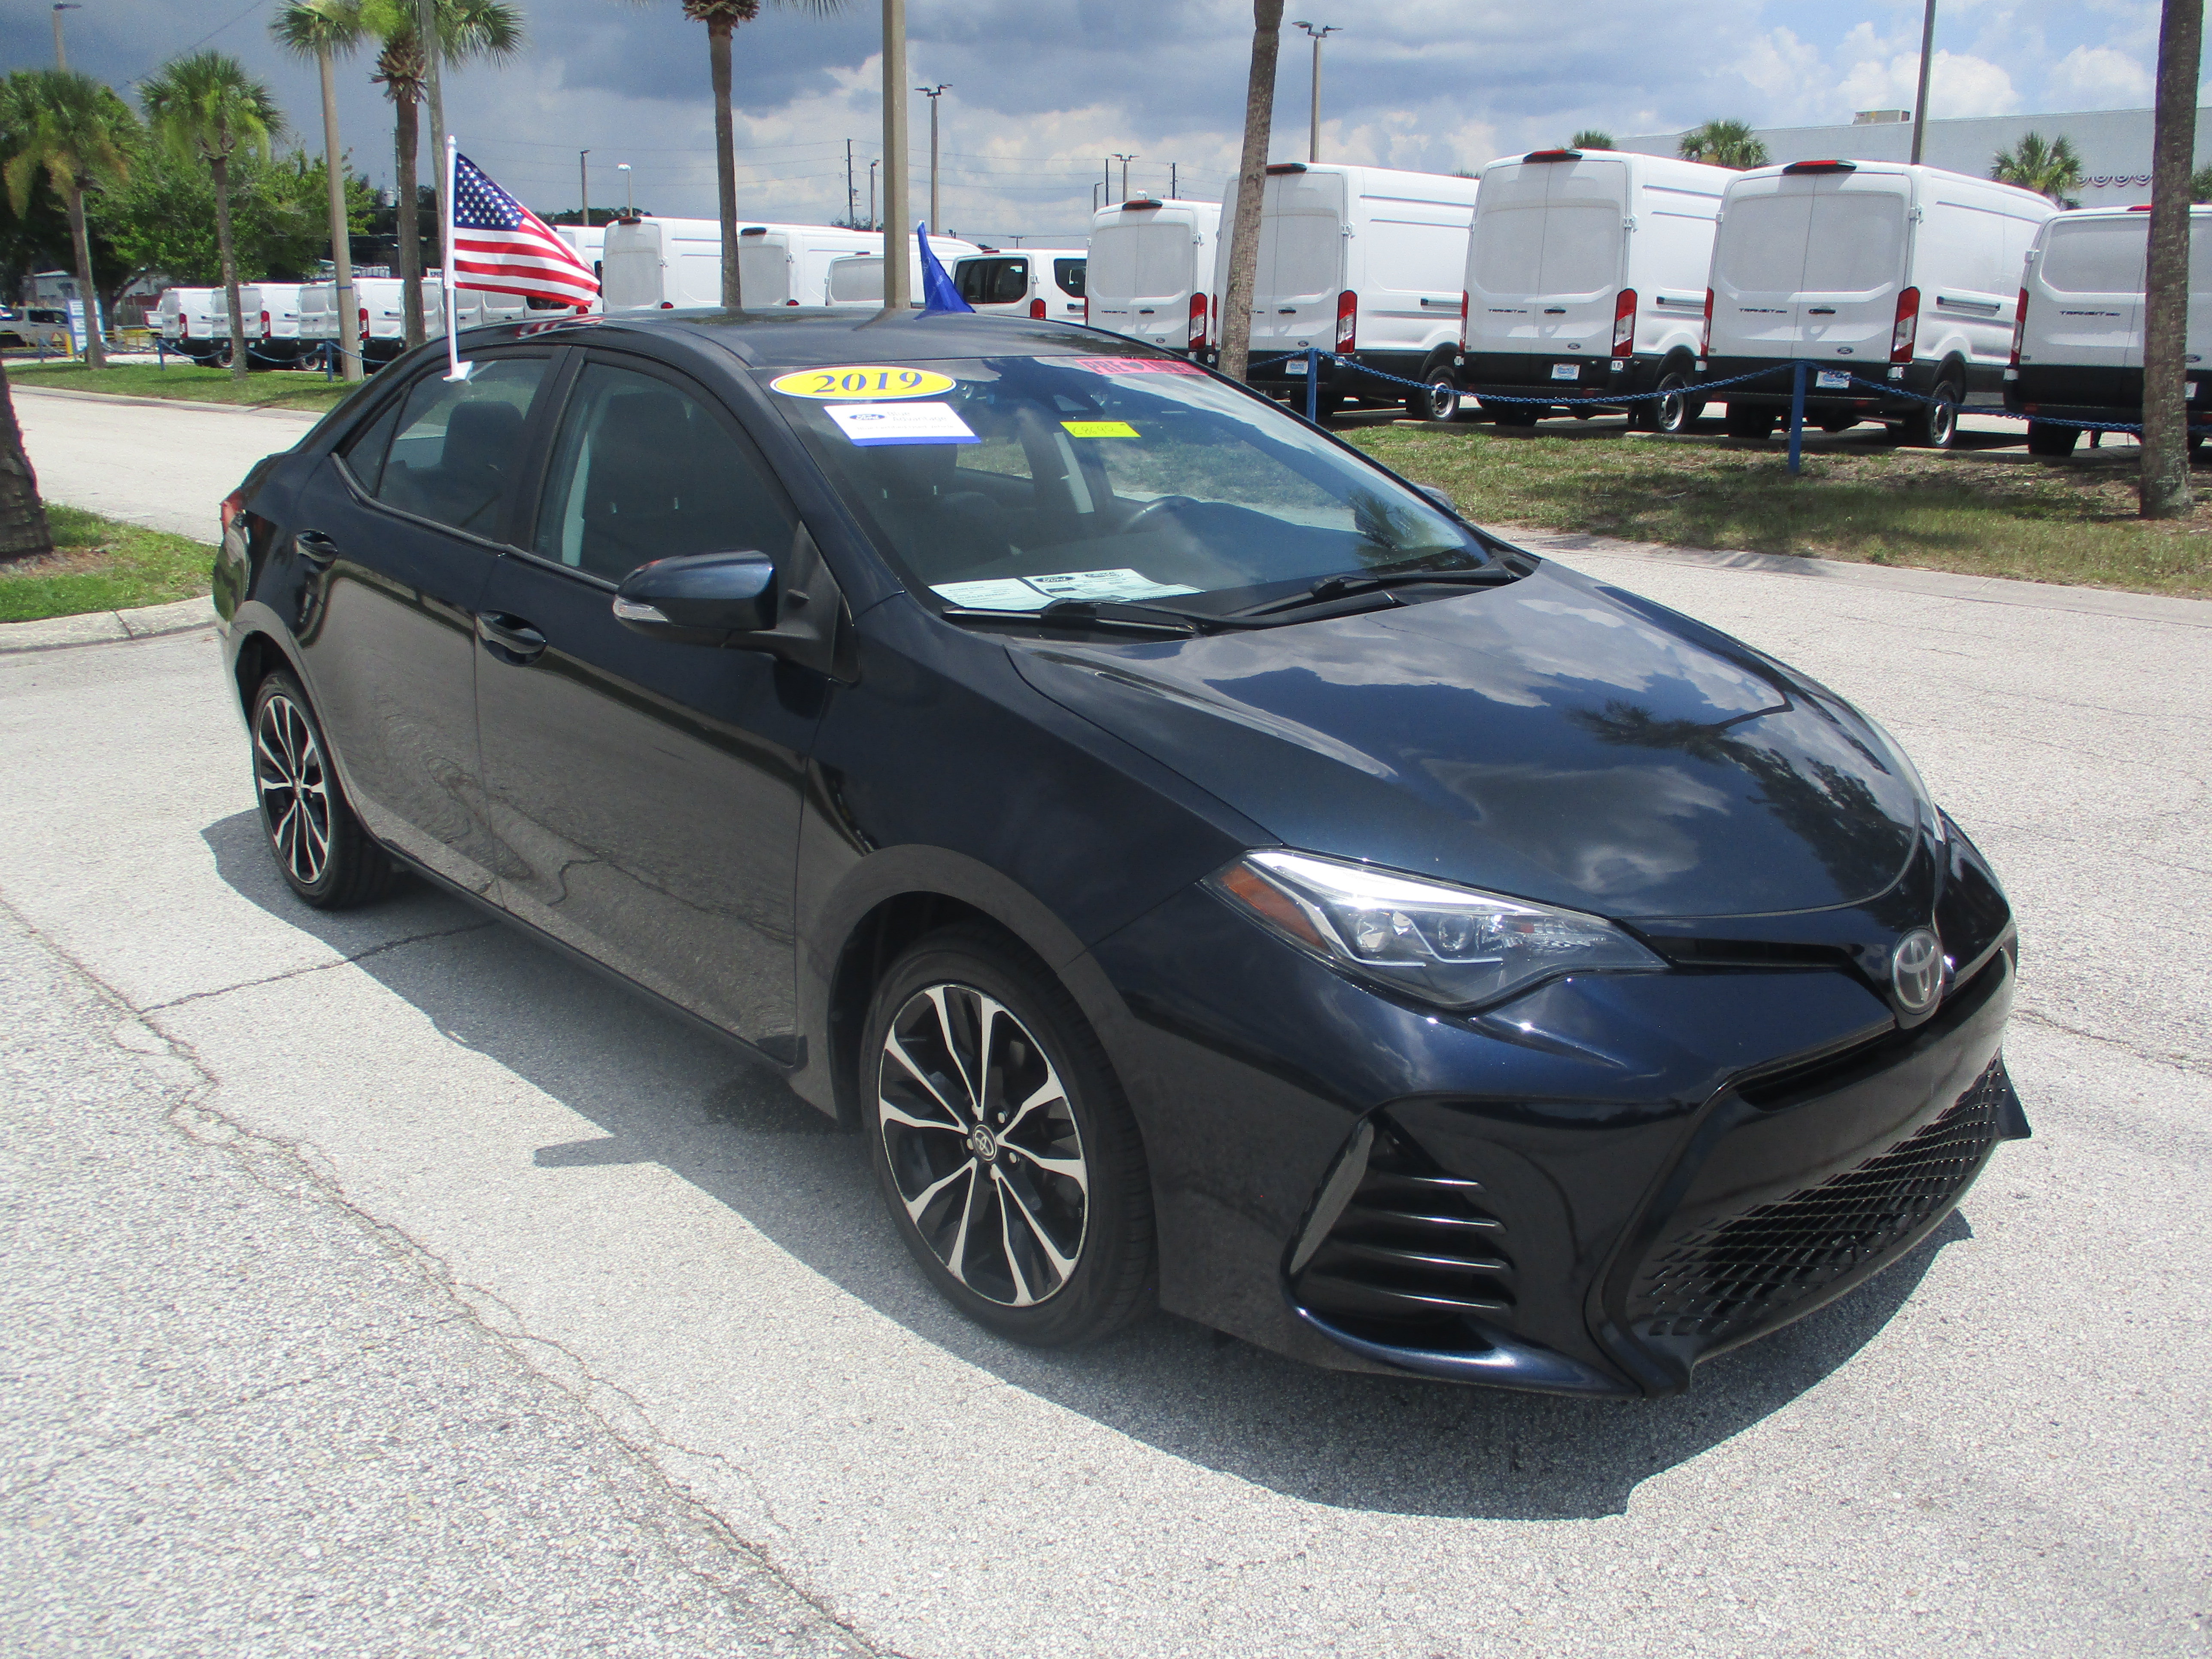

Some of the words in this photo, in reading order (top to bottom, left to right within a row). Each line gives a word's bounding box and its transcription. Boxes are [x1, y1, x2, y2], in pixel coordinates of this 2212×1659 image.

[1081, 360, 1130, 373] PRE
[811, 372, 923, 393] 2019
[1072, 425, 1122, 435] C8692
